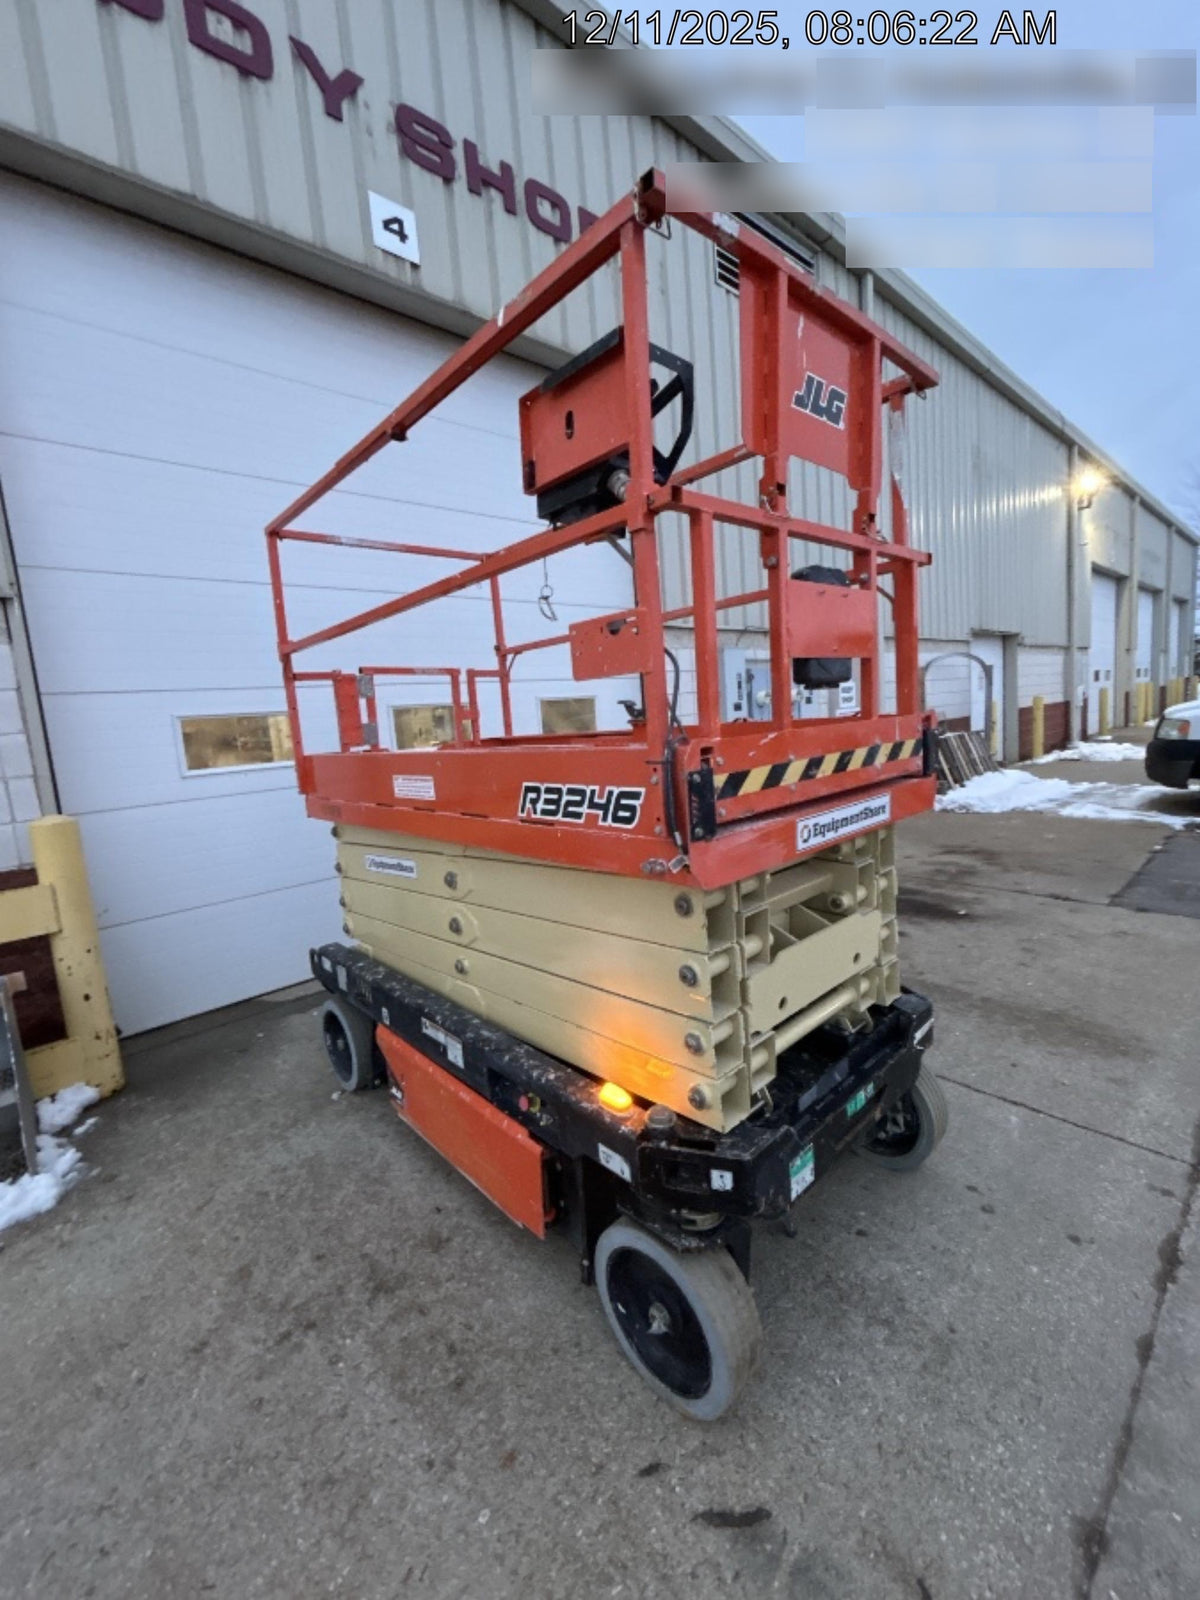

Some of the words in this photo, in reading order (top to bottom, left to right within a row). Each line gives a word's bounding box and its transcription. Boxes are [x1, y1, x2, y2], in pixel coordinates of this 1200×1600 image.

[96, 0, 364, 122] DY
[394, 102, 602, 242] SHO
[382, 216, 408, 244] 4
[791, 371, 848, 430] JLG
[518, 782, 646, 829] R3246
[812, 804, 887, 838] EquipmentShare
